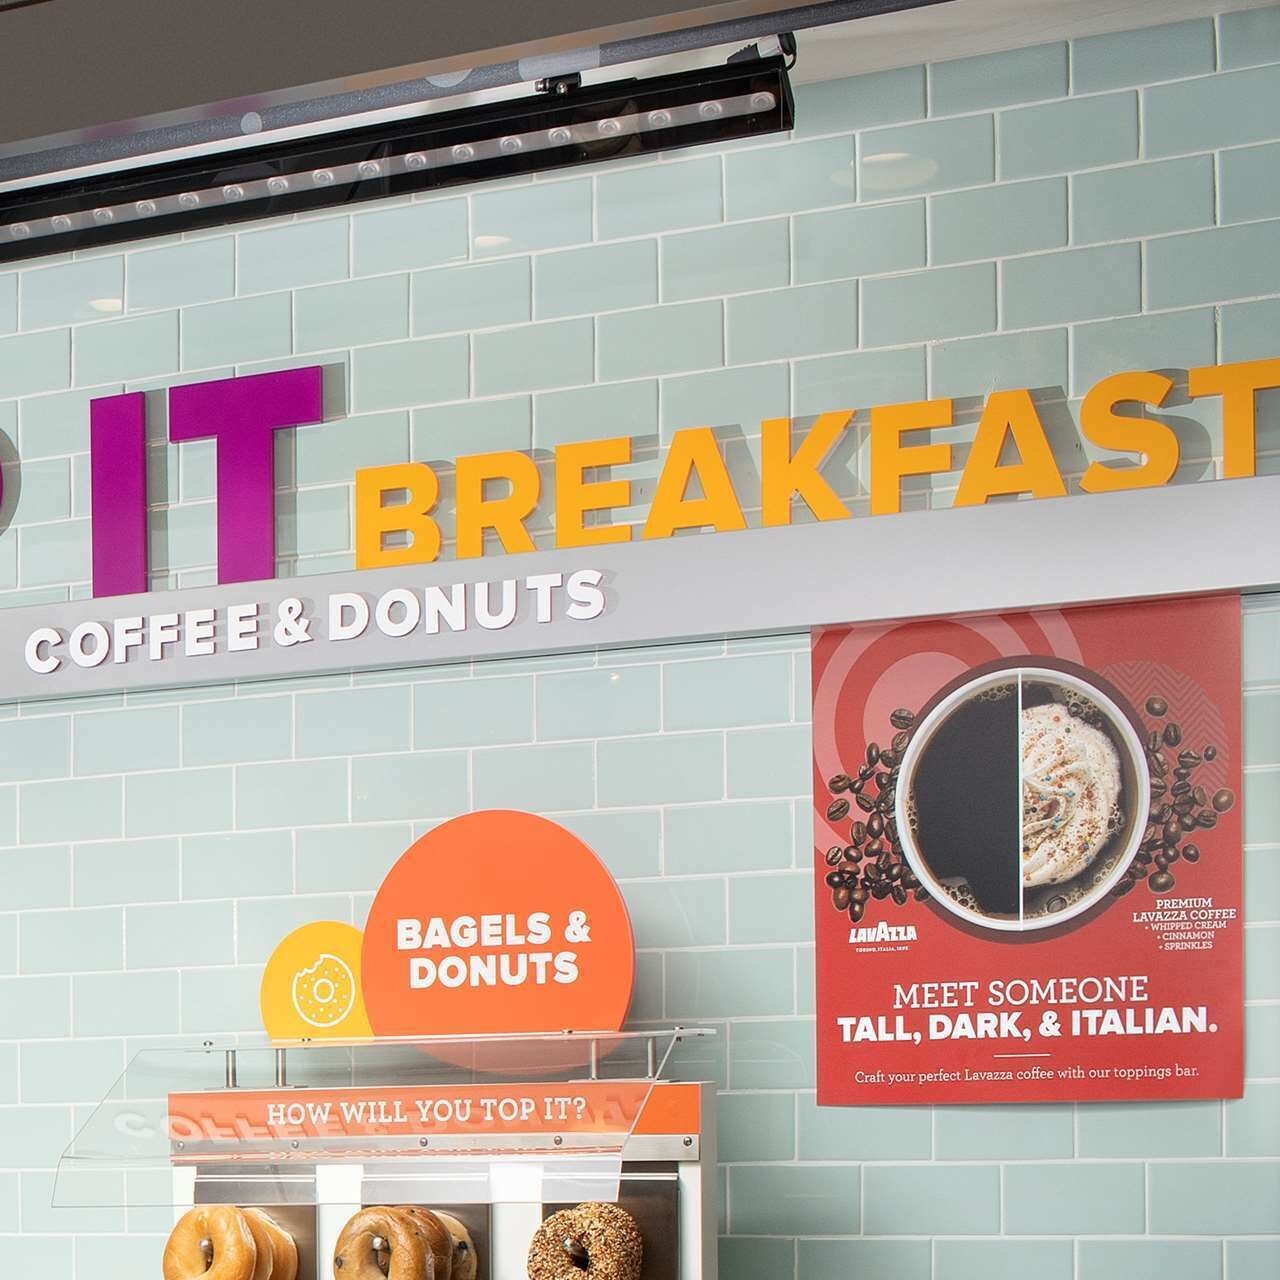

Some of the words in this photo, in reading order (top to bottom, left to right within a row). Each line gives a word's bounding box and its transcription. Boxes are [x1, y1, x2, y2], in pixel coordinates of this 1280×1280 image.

[90, 366, 323, 599] IT
[355, 358, 1280, 570] BREAKFAST
[24, 603, 259, 674] COFFEE
[274, 597, 314, 647] &
[328, 569, 607, 642] DONUTS
[1133, 910, 1188, 922] LAVAZZA
[1190, 908, 1237, 920] COFFEE
[1156, 897, 1213, 909] PREMIUM
[396, 912, 552, 950] BAGELS
[565, 911, 592, 944] &
[849, 921, 918, 943] LAVAZZA
[1151, 921, 1193, 931] WHIPPED
[1194, 920, 1227, 929] CREAM
[1162, 931, 1215, 941] CINNAMON
[1164, 941, 1213, 950] SPRINKLES
[409, 952, 578, 989] DONUTS
[893, 981, 979, 1009] MEET
[988, 975, 1149, 1006] SOMEONE
[837, 1016, 922, 1045] TALL,
[928, 1011, 1031, 1042] DARK,
[1038, 1010, 1062, 1038] &
[1071, 1006, 1218, 1037] ITALIAN.
[855, 1070, 886, 1083] Craft
[888, 1072, 916, 1085] your
[918, 1068, 961, 1085] perfect
[964, 1067, 1014, 1081] Lavazza
[1016, 1066, 1054, 1080] coffee
[1057, 1065, 1086, 1079] with
[1088, 1069, 1111, 1079] our
[1114, 1065, 1172, 1081] toppings
[1175, 1064, 1200, 1077] bar.
[267, 1102, 333, 1127] HOW
[339, 1100, 409, 1124] WILL
[414, 1098, 474, 1123] YOU
[480, 1097, 536, 1121] TOP
[544, 1096, 587, 1120] IT?
